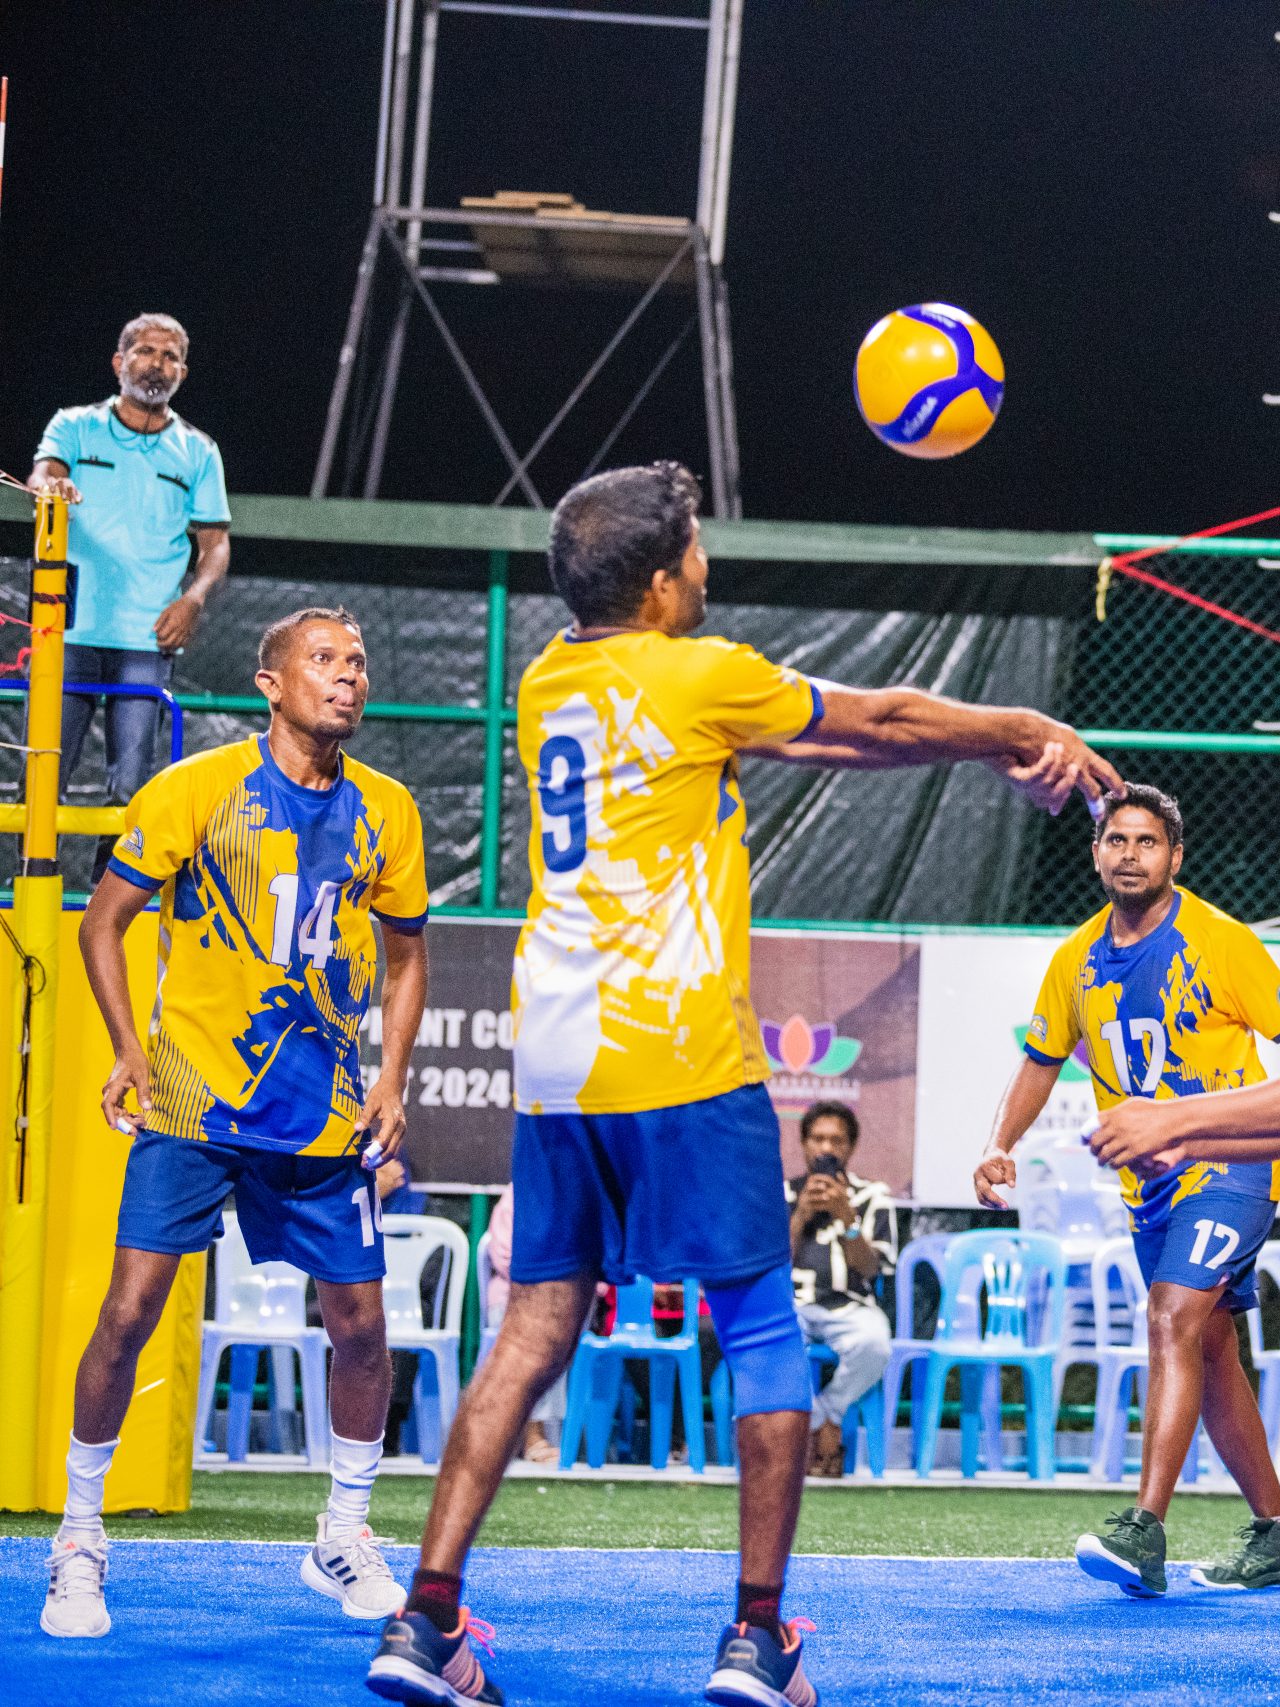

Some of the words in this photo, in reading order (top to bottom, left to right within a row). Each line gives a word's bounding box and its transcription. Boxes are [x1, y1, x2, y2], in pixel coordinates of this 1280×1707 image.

[537, 735, 587, 873] 9
[268, 872, 342, 970] 14
[419, 1066, 512, 1109] 2024
[1100, 1017, 1167, 1093] 17
[1188, 1218, 1240, 1270] 17
